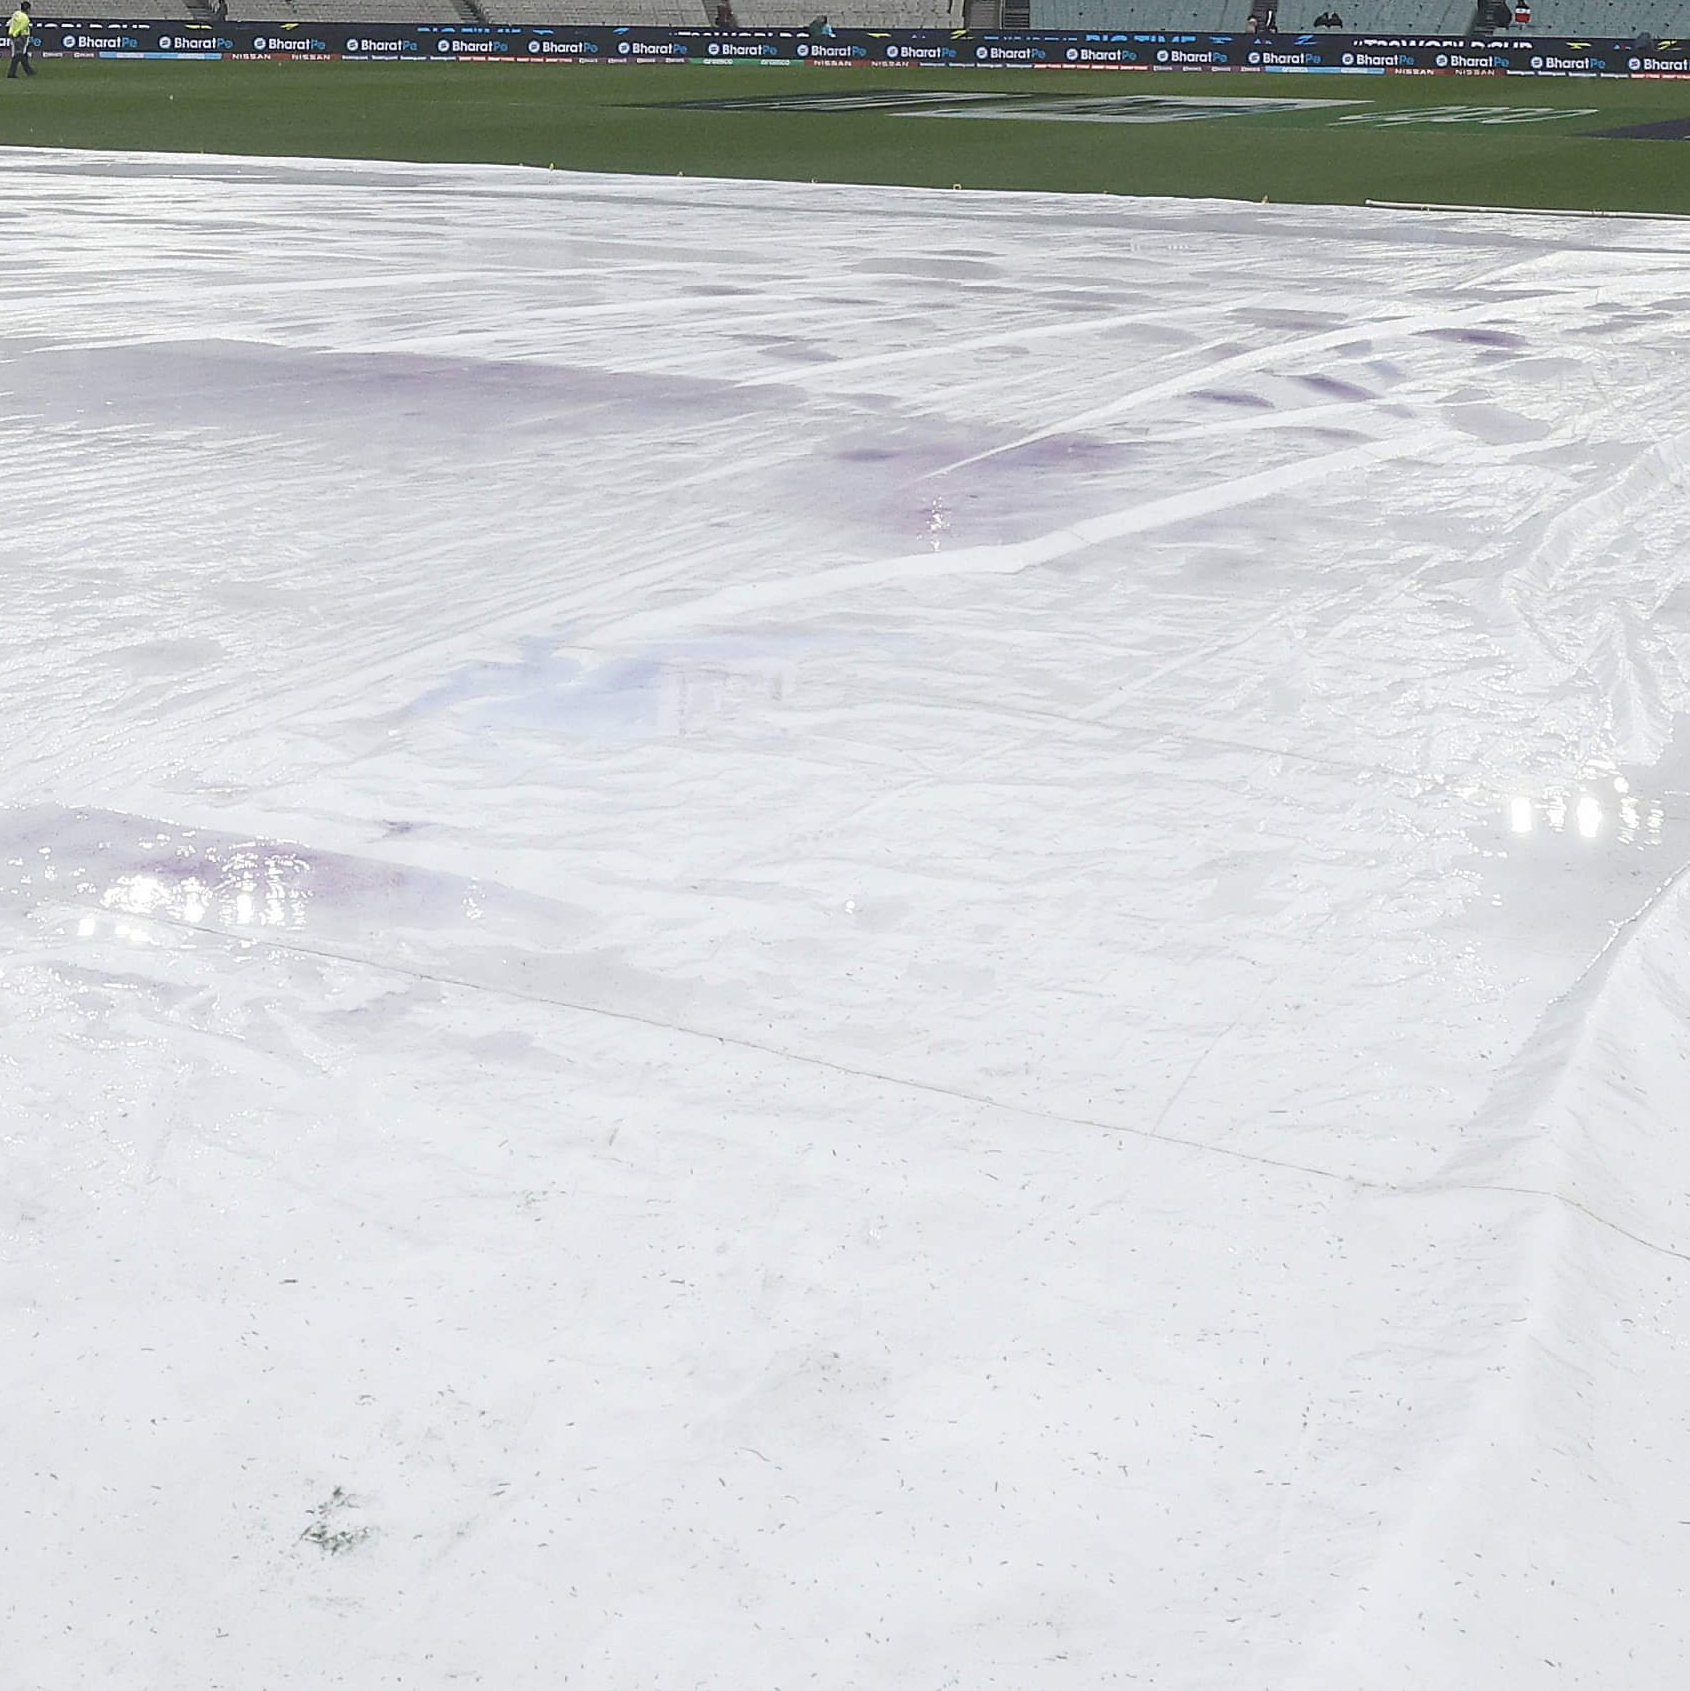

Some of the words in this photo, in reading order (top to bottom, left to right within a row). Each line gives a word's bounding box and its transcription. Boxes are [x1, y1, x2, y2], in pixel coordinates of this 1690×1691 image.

[78, 36, 138, 48] BharatPe
[268, 38, 326, 51] BharatPe
[452, 40, 508, 53] BharatPe
[632, 42, 687, 55] BharatPe
[811, 45, 867, 58] BharatPe
[990, 48, 1046, 60] BharatPe
[1171, 50, 1227, 63] BharatPe
[1356, 54, 1414, 66] BharatPe
[1546, 57, 1605, 69] BharatPe
